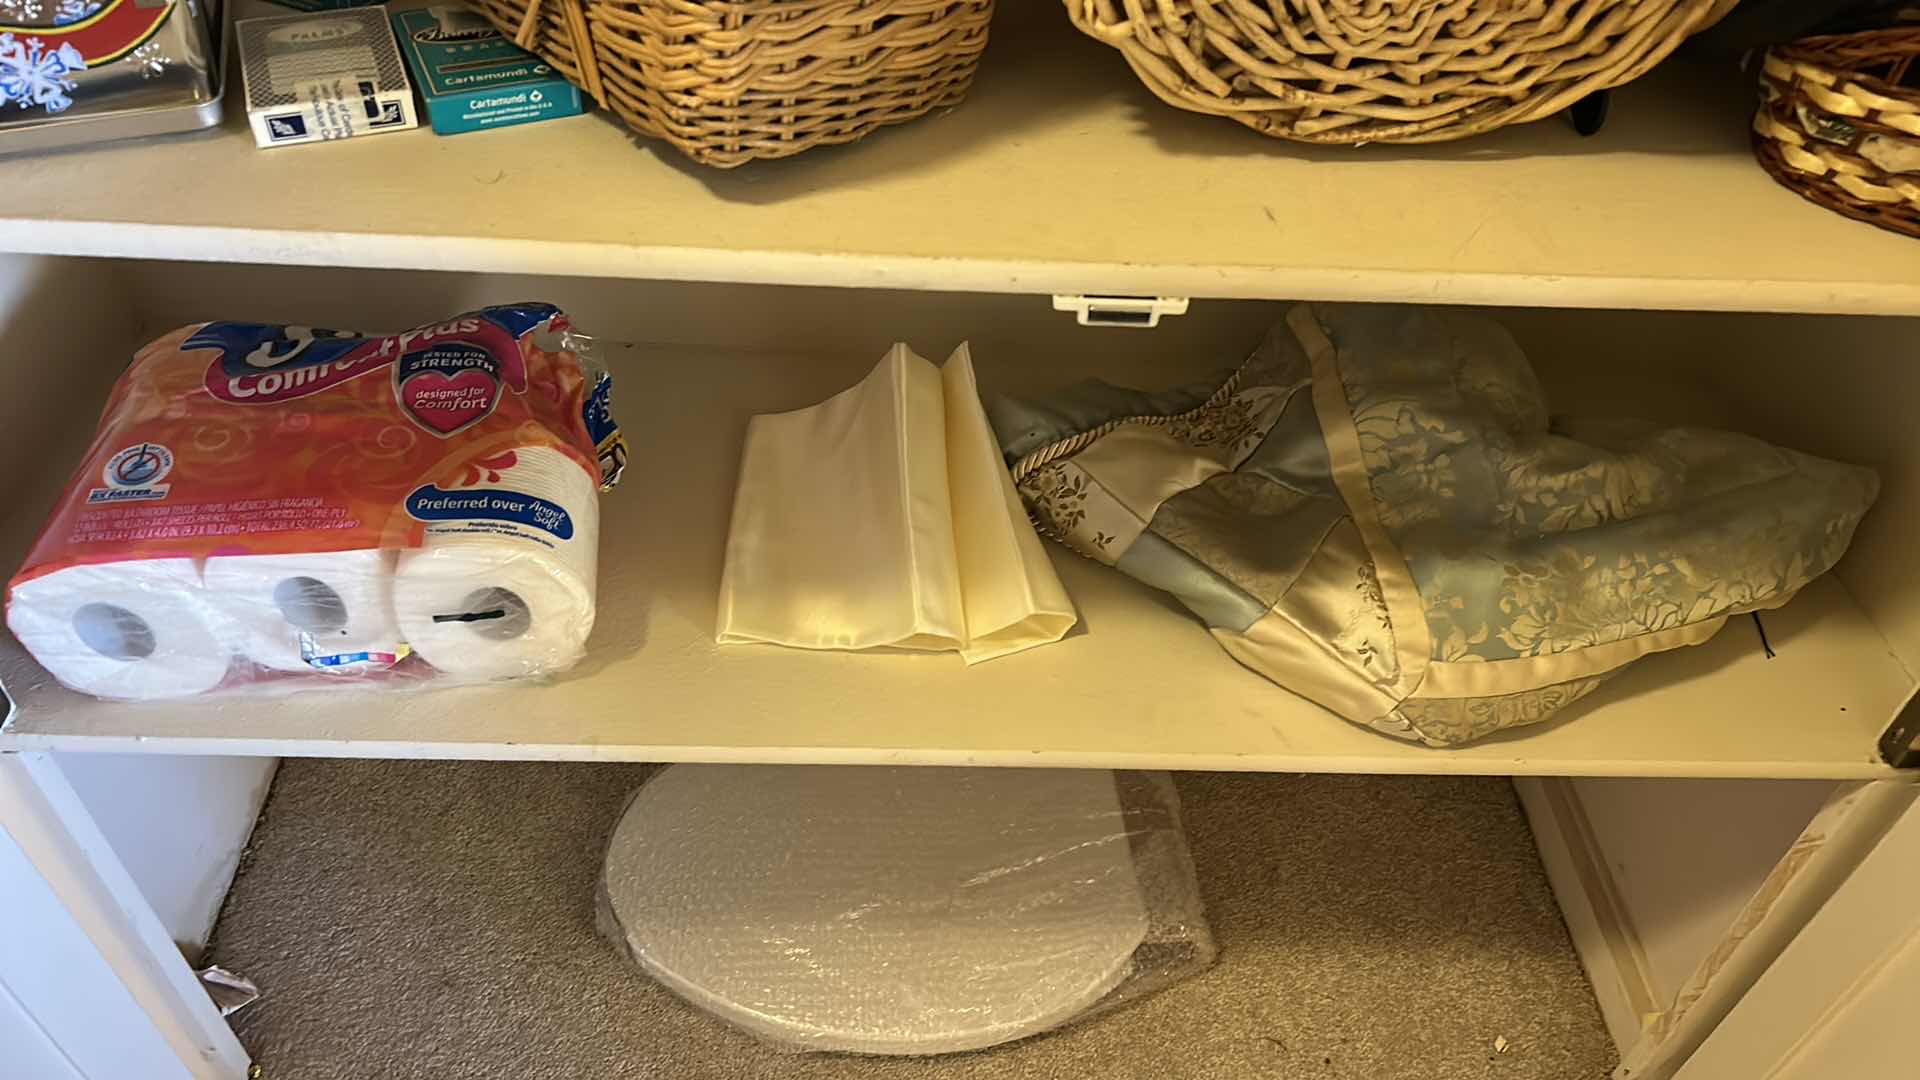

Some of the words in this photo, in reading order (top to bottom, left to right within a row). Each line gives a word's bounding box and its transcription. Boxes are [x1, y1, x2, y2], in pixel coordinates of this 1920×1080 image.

[444, 68, 529, 86] Cartamundi
[470, 93, 527, 110] Cartamundi
[409, 358, 494, 373] STRENGTH
[415, 386, 469, 400] designed
[468, 386, 486, 399] for
[414, 397, 488, 412] Comfort
[417, 496, 488, 510] Preferred
[491, 499, 525, 513] over
[528, 500, 566, 520] Angel
[533, 511, 561, 531] Soft
